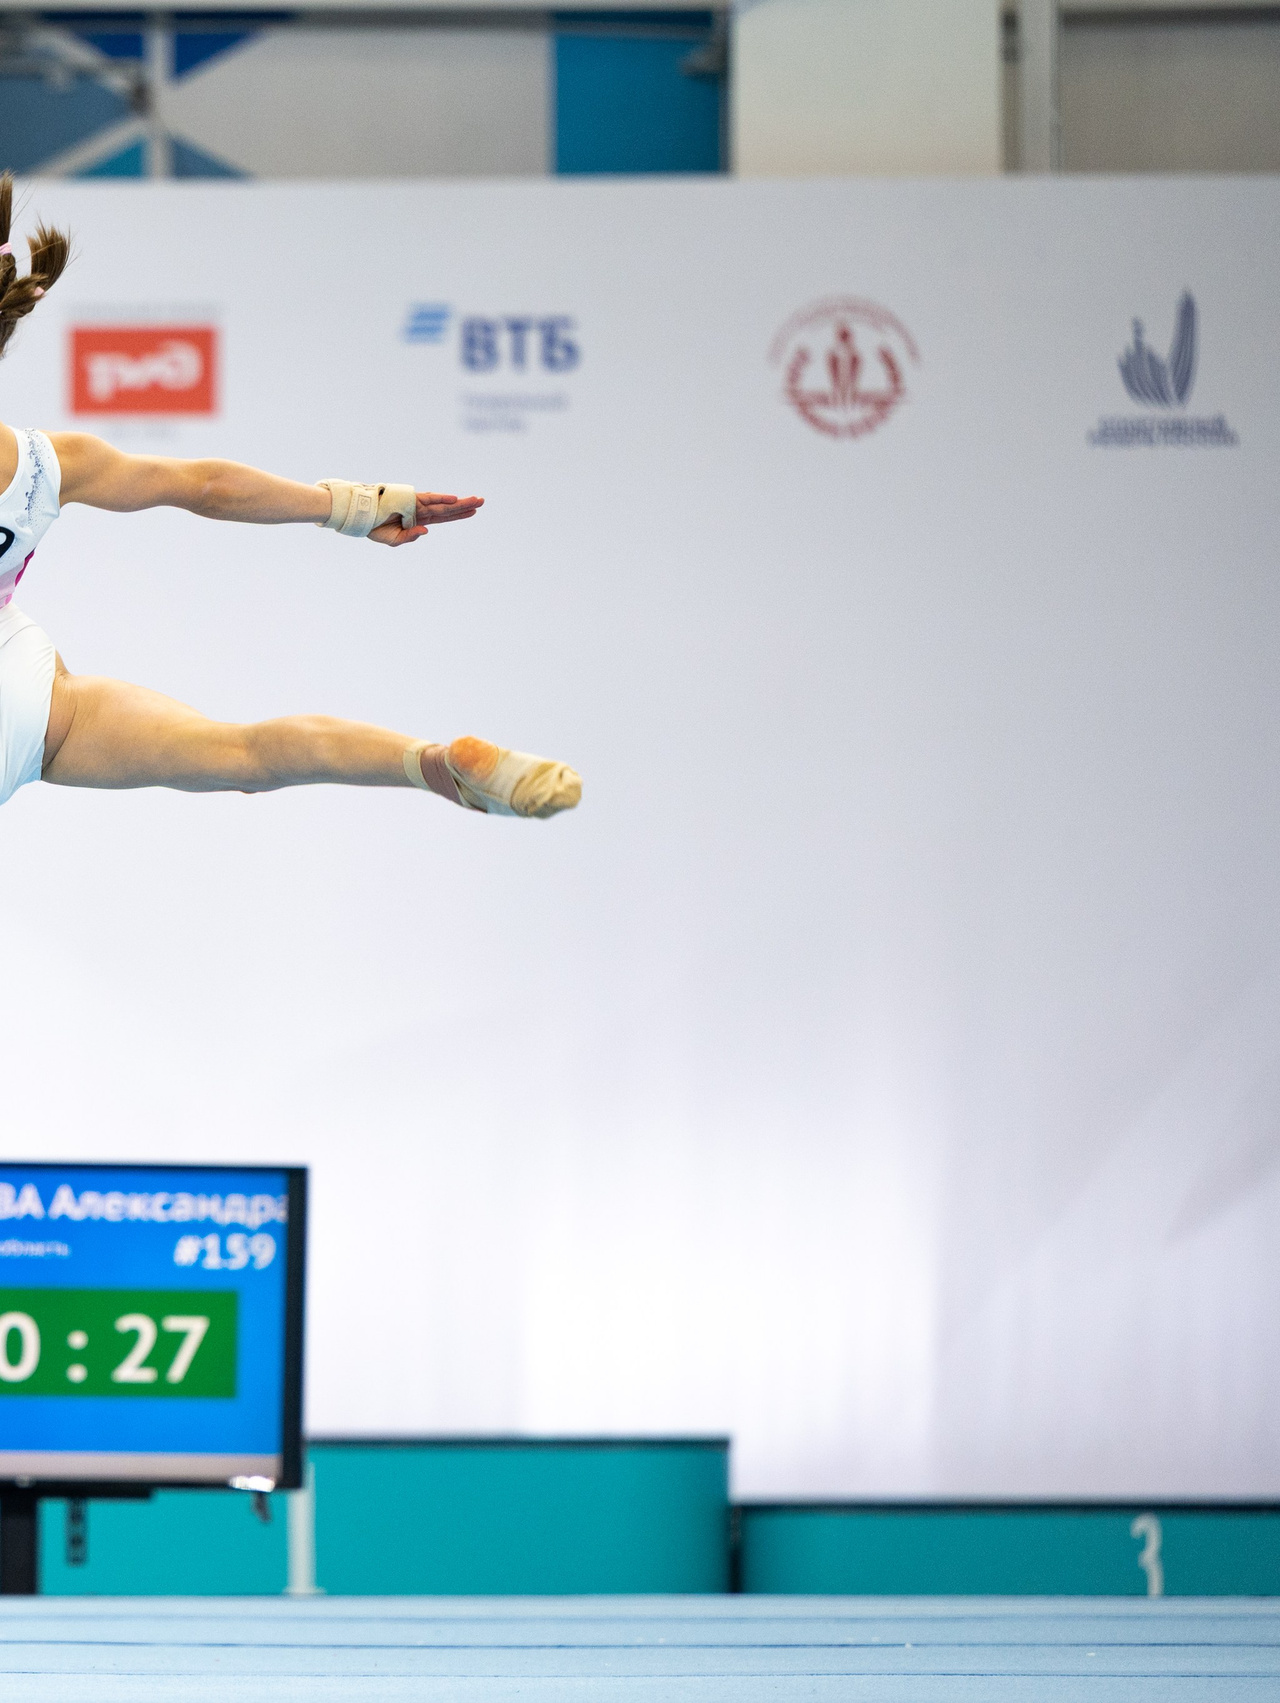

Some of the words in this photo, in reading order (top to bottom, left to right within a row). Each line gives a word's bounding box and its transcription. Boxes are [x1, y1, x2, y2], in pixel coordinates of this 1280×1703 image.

[460, 314, 580, 373] ВТБ
[173, 1232, 277, 1270] #159
[111, 1313, 211, 1385] 27
